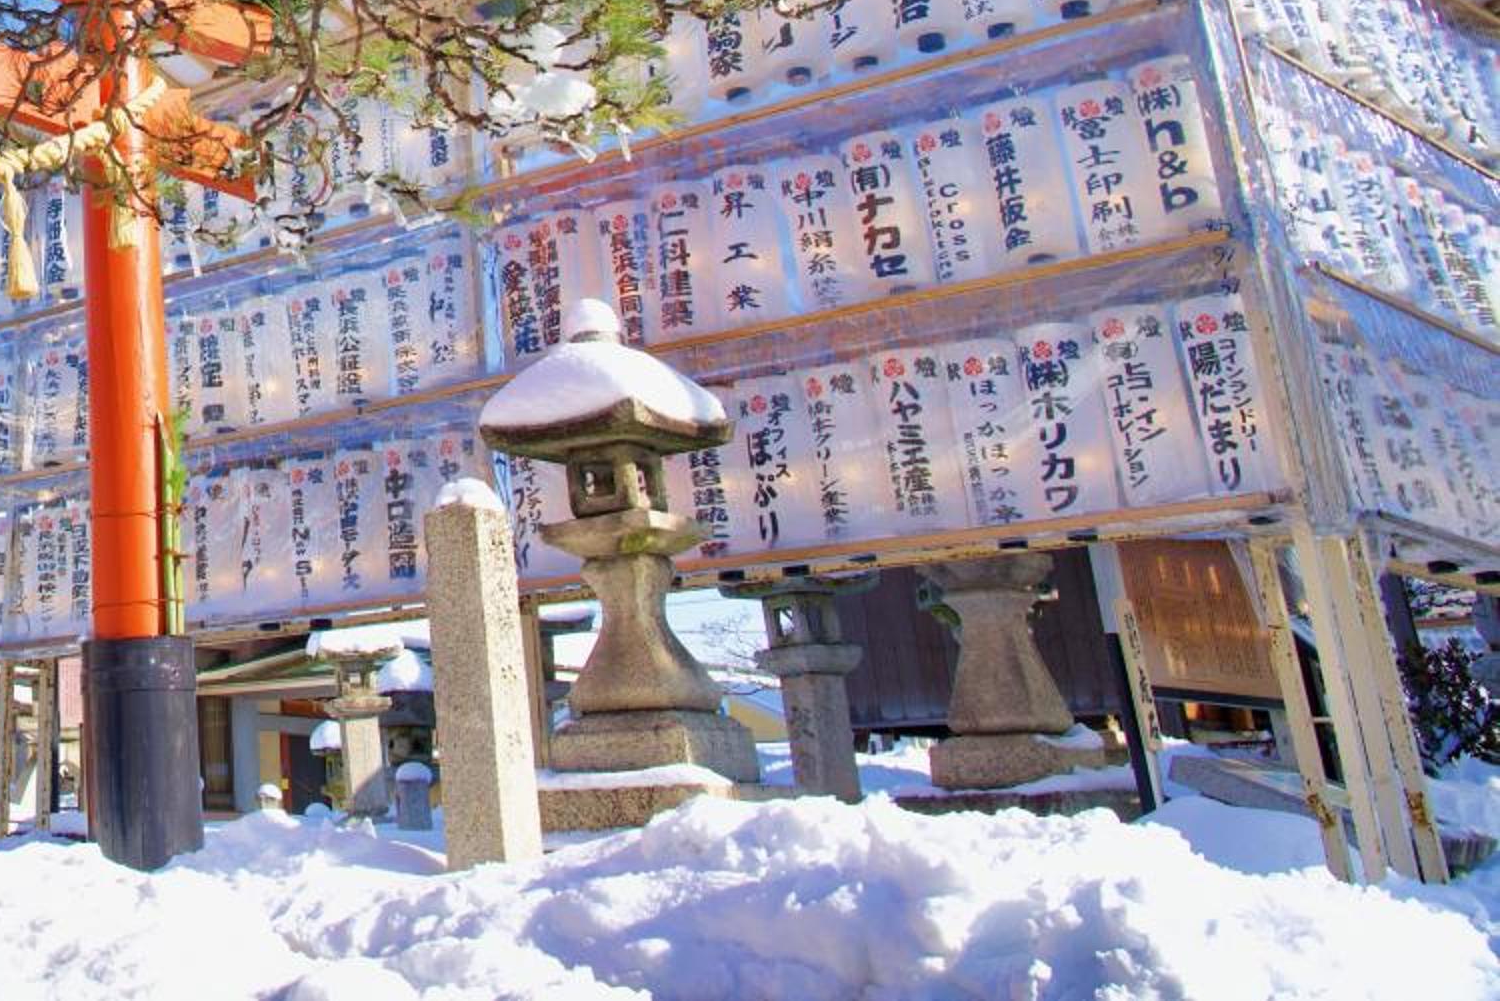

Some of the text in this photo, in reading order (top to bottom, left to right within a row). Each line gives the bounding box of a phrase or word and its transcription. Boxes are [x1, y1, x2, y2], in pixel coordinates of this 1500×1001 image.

[766, 410, 792, 480] オフィス
[969, 379, 1024, 525] ほっかほっか亭
[1107, 373, 1149, 488] コーポレーション
[1187, 340, 1242, 491] 陽だまり
[1218, 337, 1258, 452] コインランドリー
